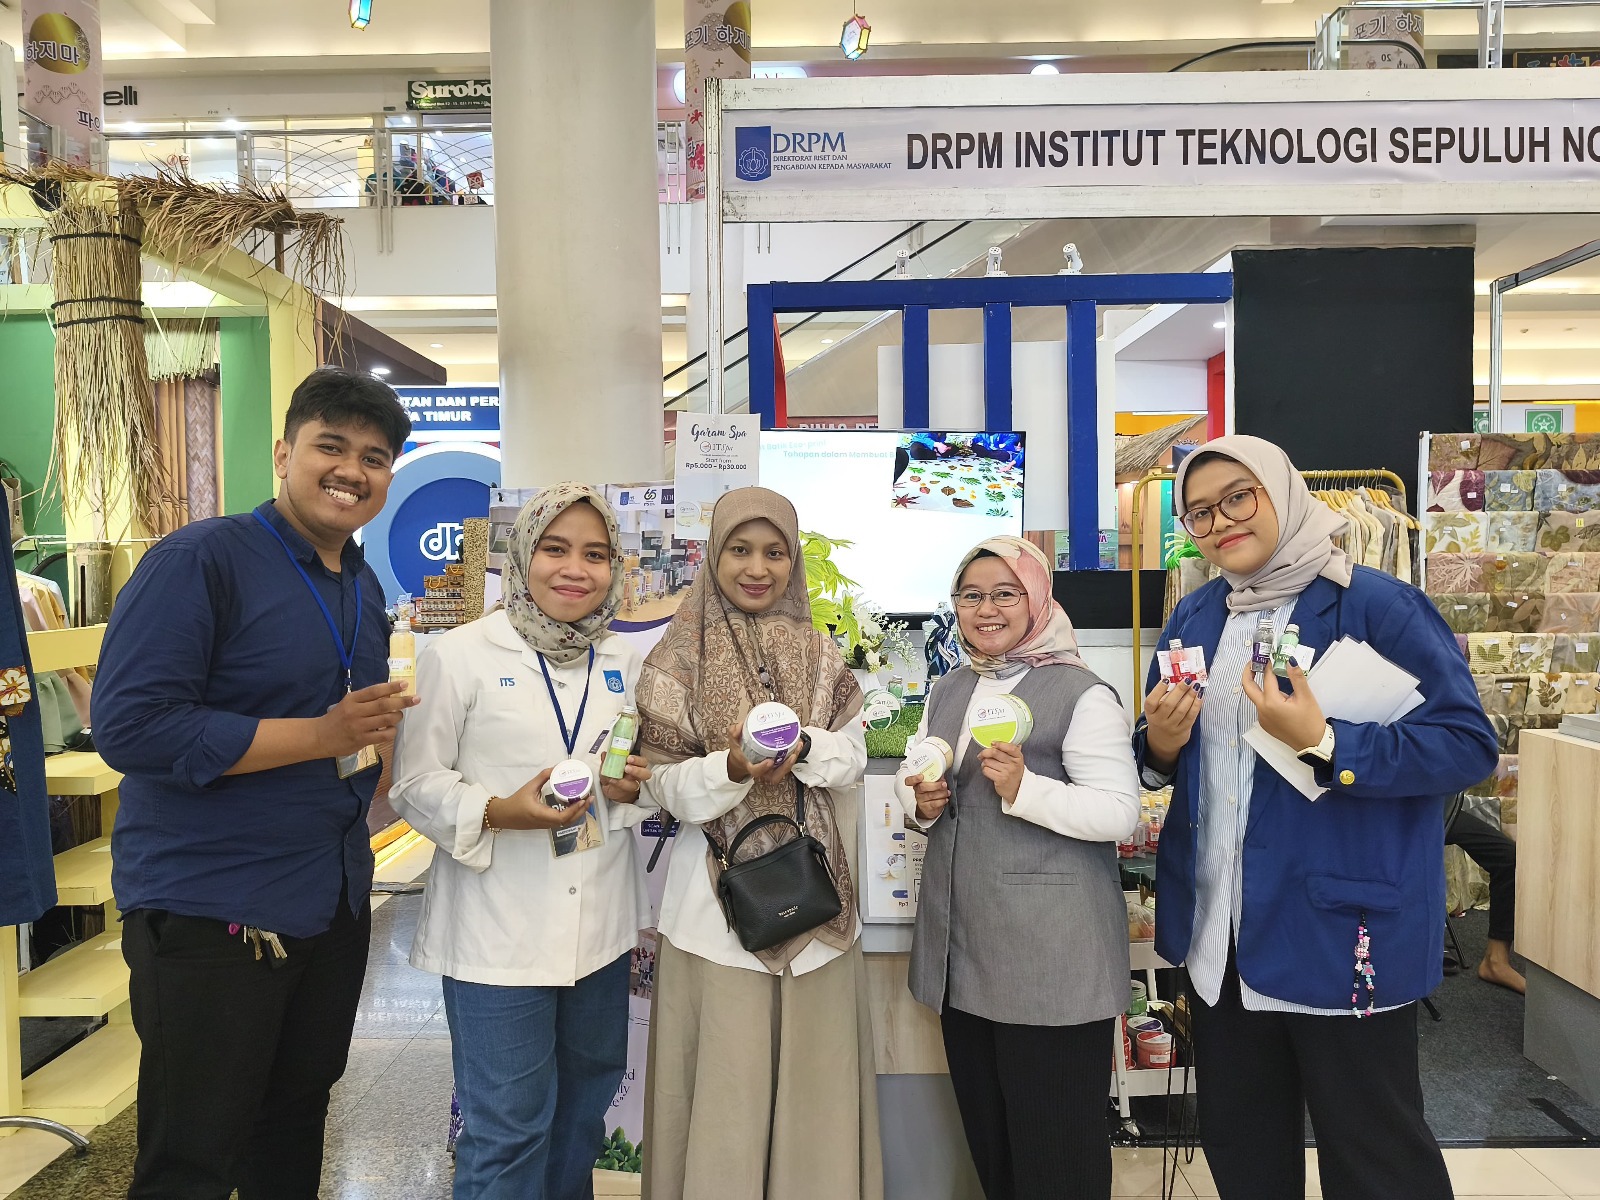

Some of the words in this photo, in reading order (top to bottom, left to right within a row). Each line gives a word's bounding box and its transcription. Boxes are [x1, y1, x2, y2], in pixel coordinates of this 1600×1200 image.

[773, 132, 847, 154] DRPM
[906, 132, 1003, 170] DRPM
[1015, 129, 1165, 168] INSTITUT
[1175, 127, 1378, 166] TEKNOLOGI
[1388, 126, 1550, 165] SEPULUH
[818, 163, 845, 171] KEPADA
[848, 162, 892, 170] MASYARAKAT
[435, 395, 467, 407] DAN
[422, 410, 472, 422] TIMUR
[691, 423, 726, 442] Garam
[728, 424, 747, 440] Spa
[783, 450, 820, 460] Tahapan
[821, 450, 848, 458] dalam
[849, 451, 886, 459] Membuat
[685, 462, 713, 470] Rp5.000
[718, 463, 747, 471] Rp30.000
[499, 677, 516, 687] ITS
